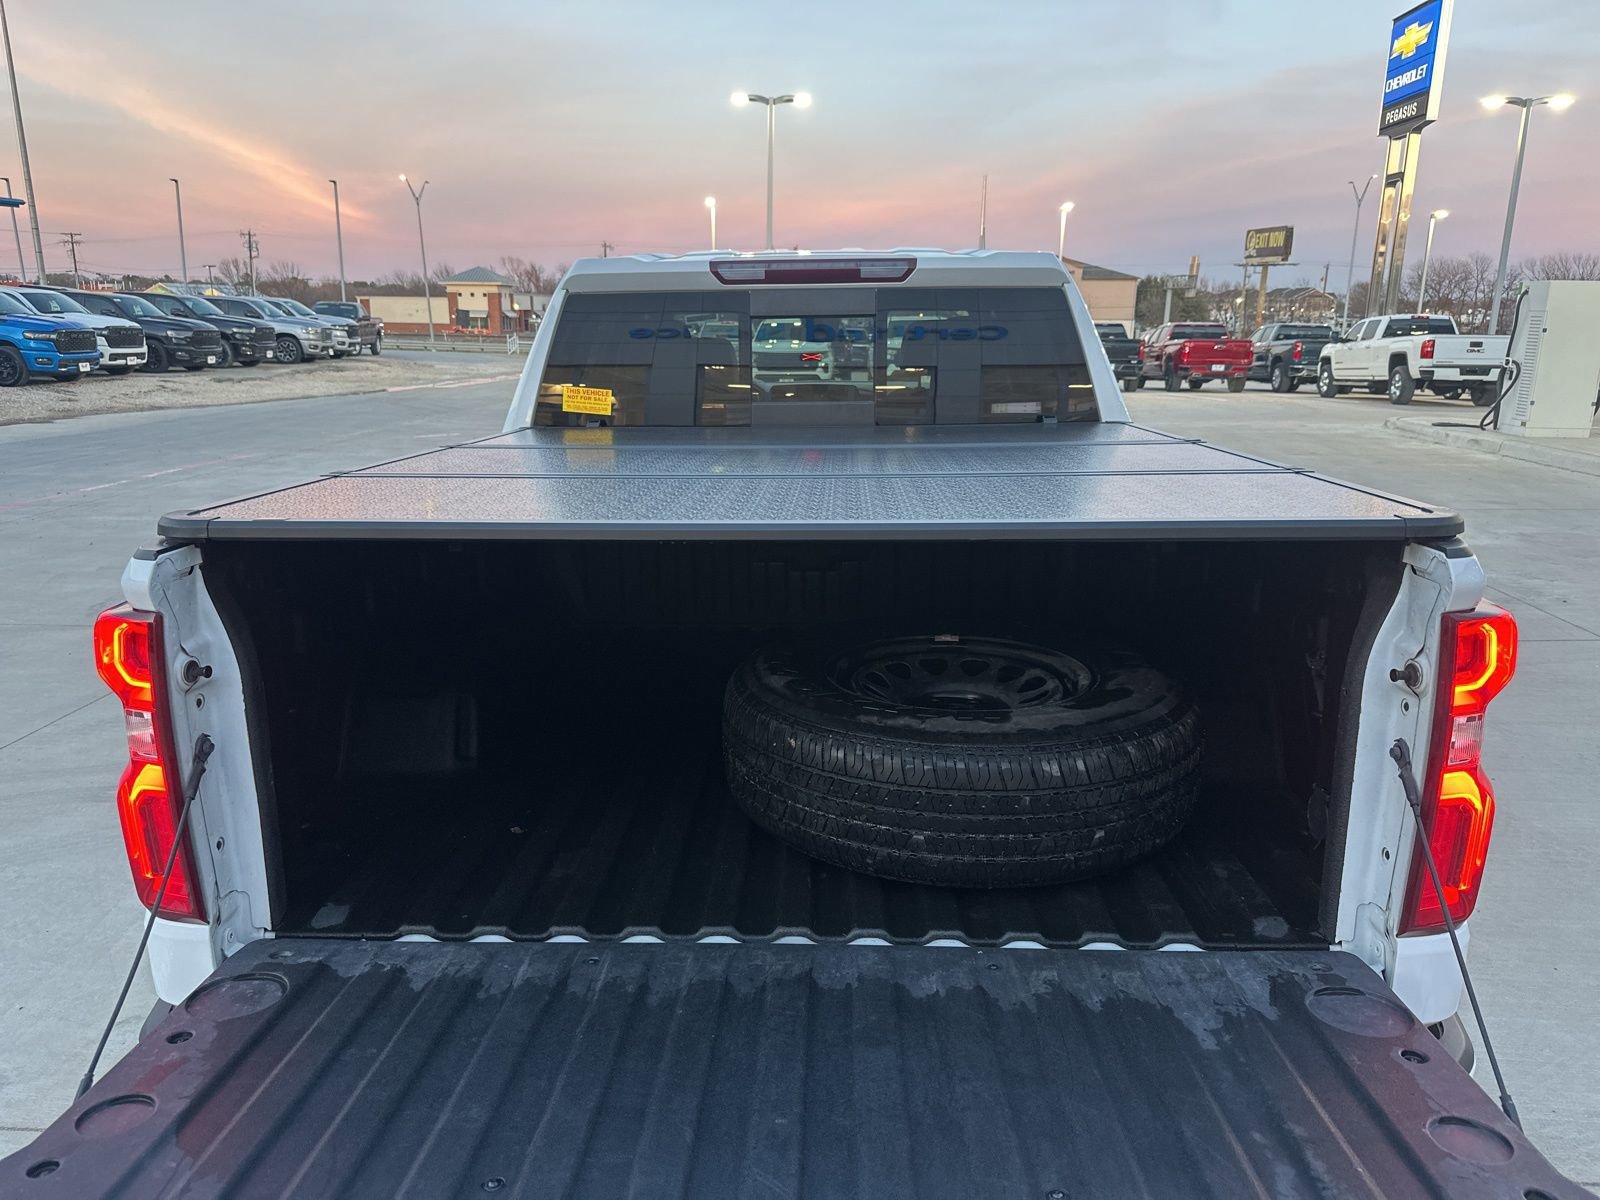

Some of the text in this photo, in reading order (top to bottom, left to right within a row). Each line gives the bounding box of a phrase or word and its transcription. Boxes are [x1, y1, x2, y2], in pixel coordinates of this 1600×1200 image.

[1385, 64, 1428, 93] CHEVROLET
[1385, 102, 1418, 125] PEGASUS
[582, 389, 609, 397] VEHICLE
